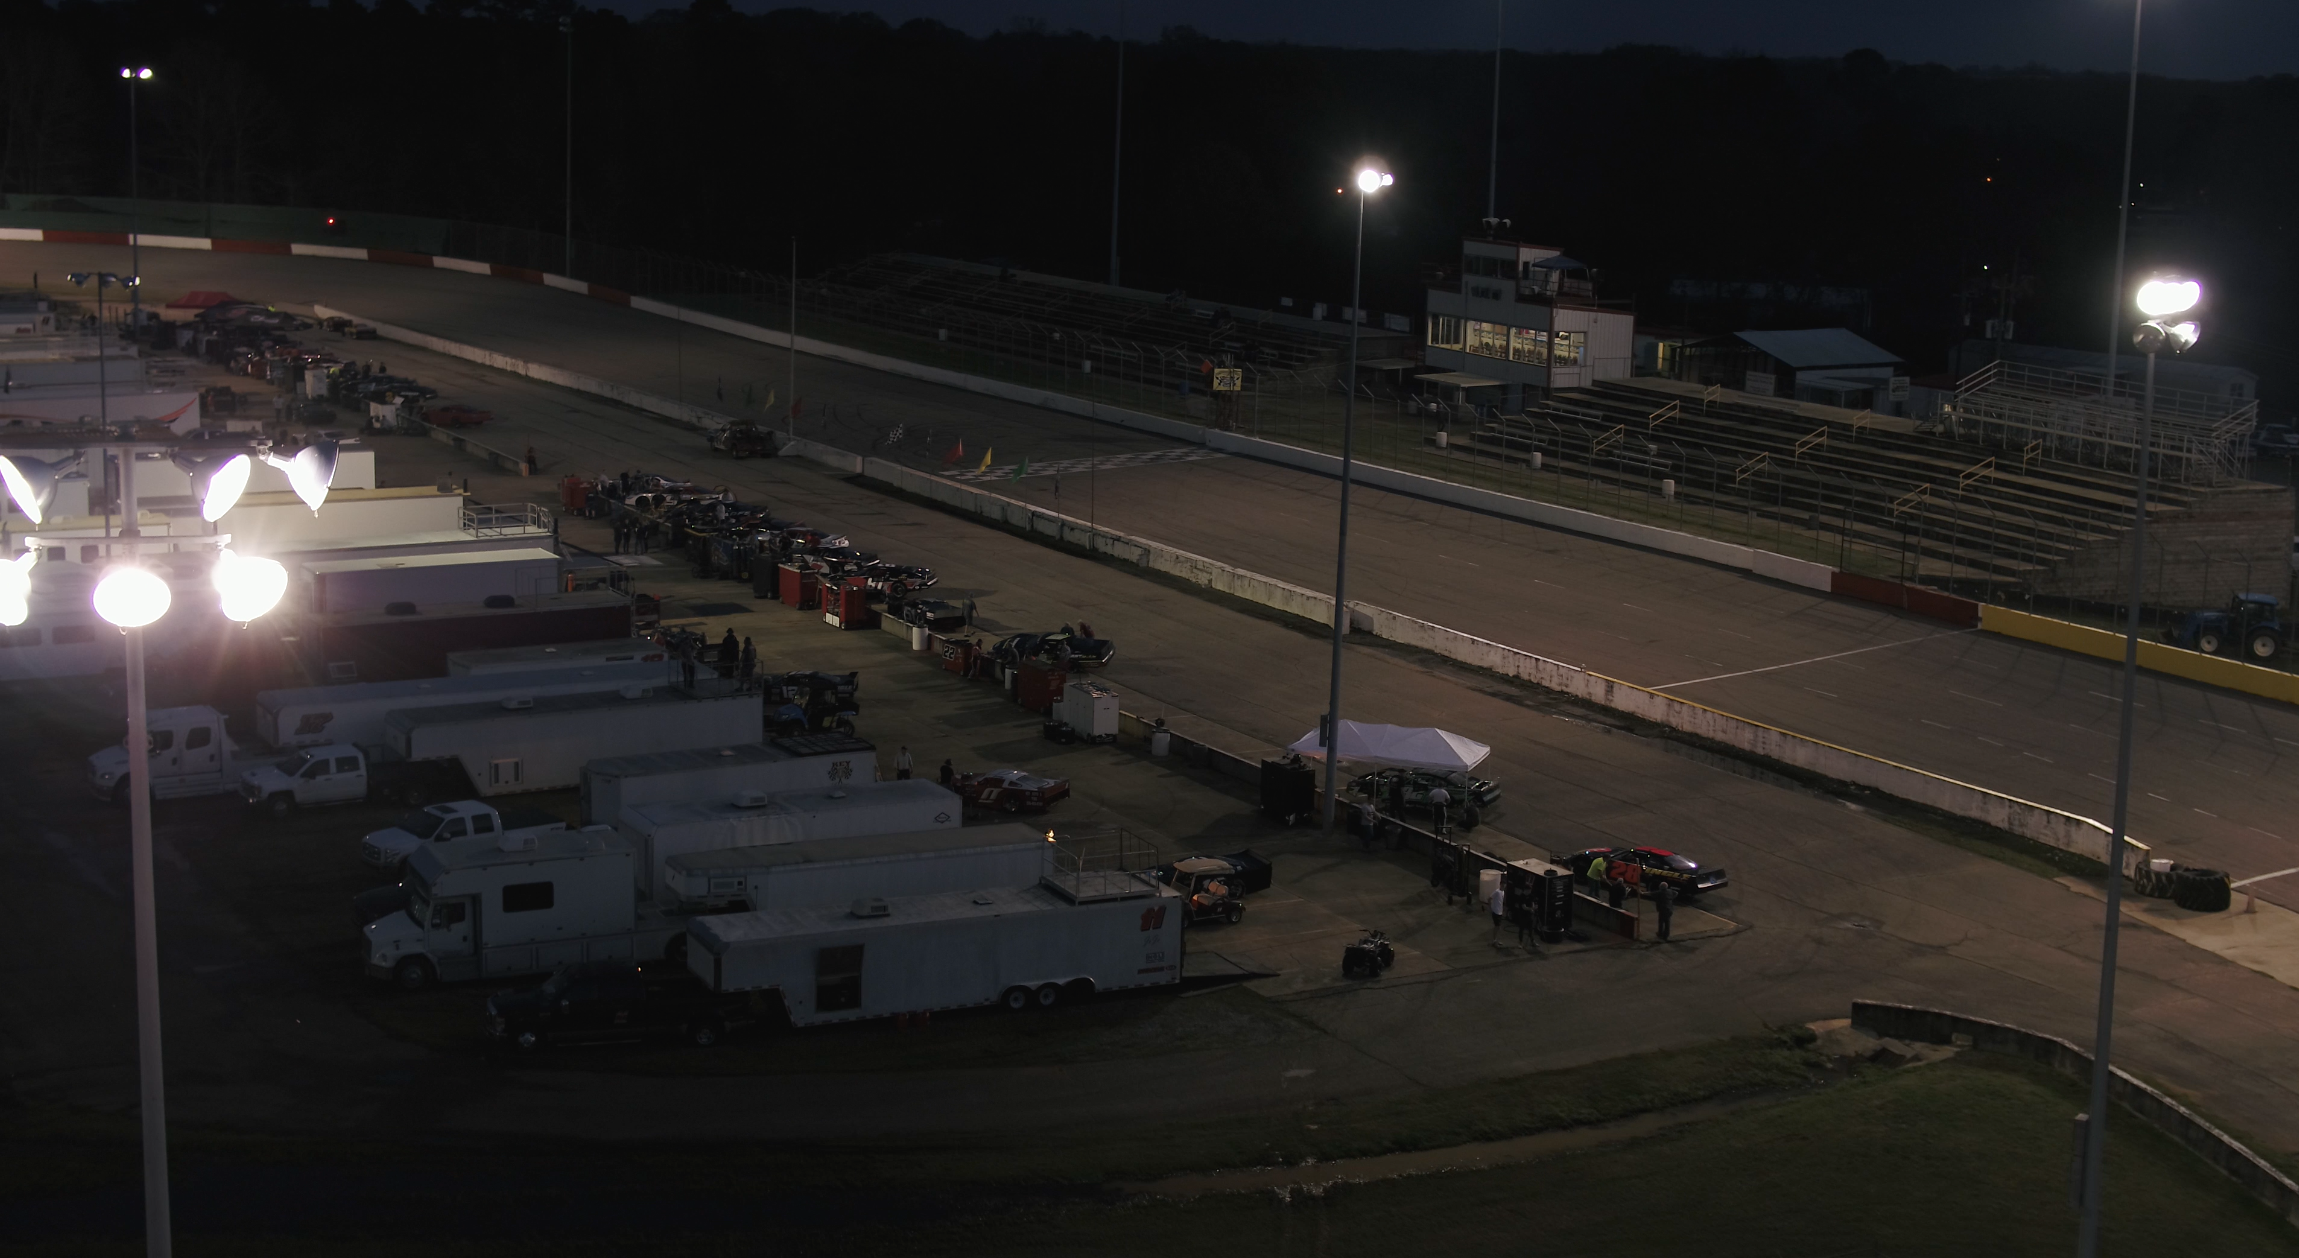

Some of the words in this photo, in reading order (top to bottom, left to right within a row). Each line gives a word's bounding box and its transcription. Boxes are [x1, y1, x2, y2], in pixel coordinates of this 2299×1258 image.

[943, 645, 955, 660] 22
[832, 760, 851, 768] KEY
[1609, 860, 1642, 884] 28
